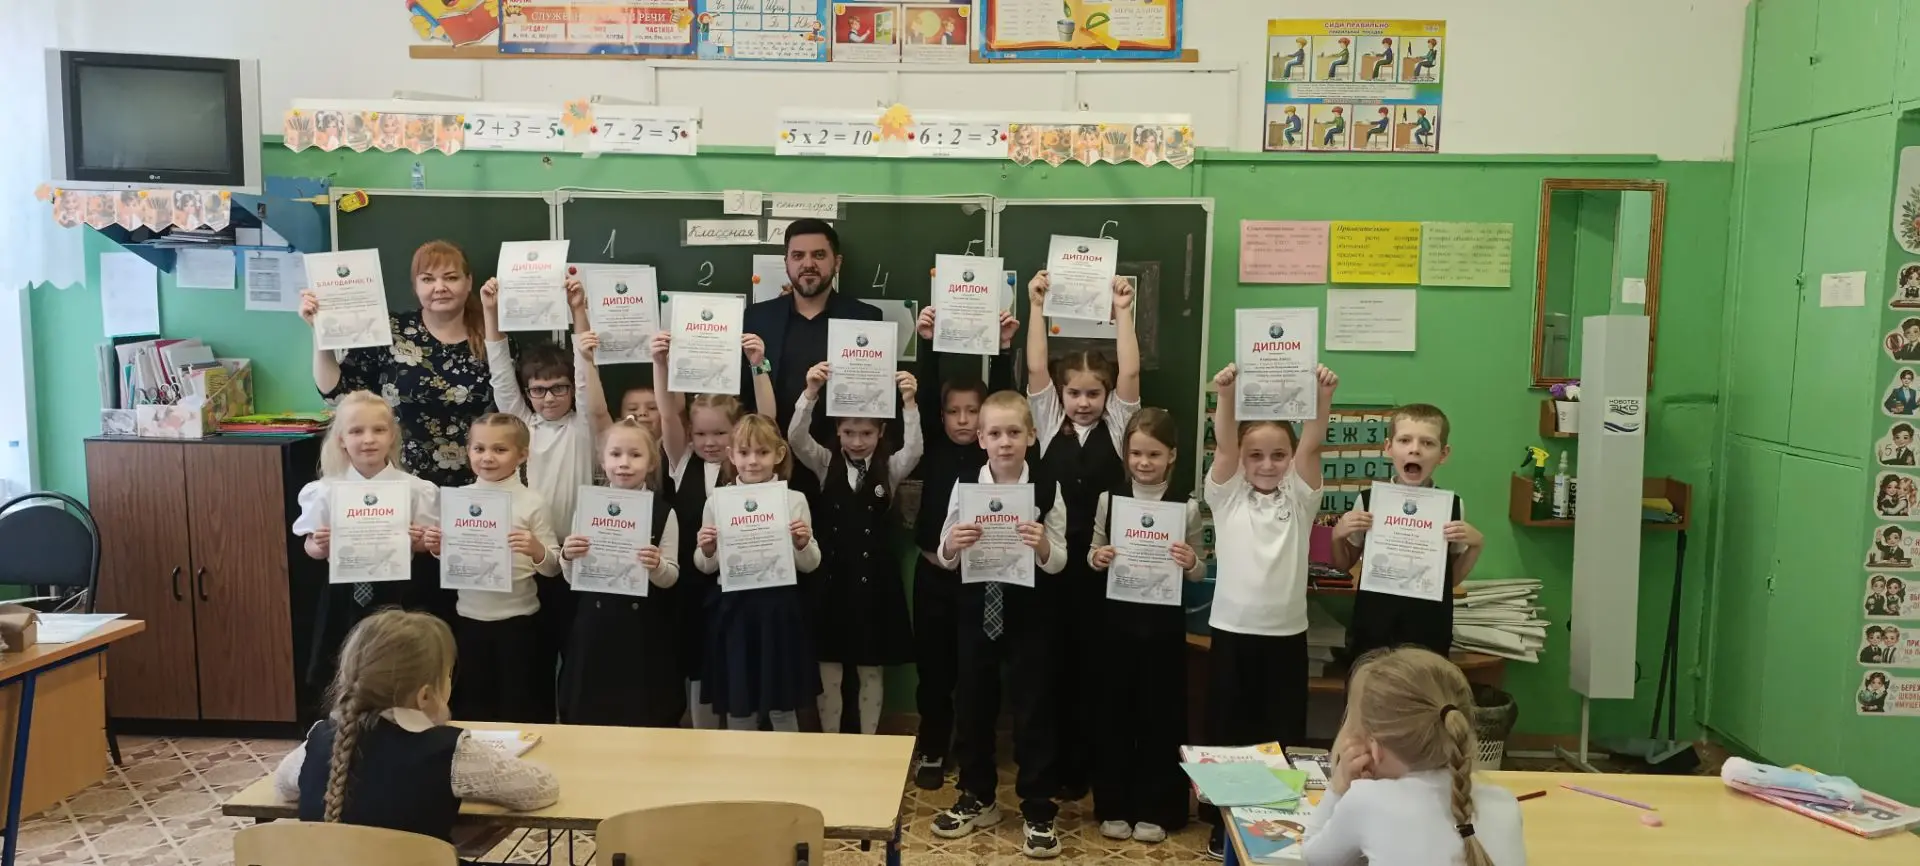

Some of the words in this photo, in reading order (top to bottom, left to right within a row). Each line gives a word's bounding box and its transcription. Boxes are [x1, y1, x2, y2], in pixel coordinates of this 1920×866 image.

[639, 13, 666, 22] РЕЧИ
[474, 119, 486, 136] 2
[492, 121, 504, 136] +
[509, 120, 521, 138] 3
[546, 122, 558, 139] 5
[604, 122, 614, 138] 7
[632, 124, 644, 140] 2
[668, 126, 680, 142] 5
[787, 128, 797, 144] 5
[818, 128, 828, 144] 2
[852, 130, 872, 146] 10
[920, 128, 930, 144] 6
[950, 128, 962, 146] 2
[986, 129, 998, 146] 3
[688, 225, 756, 239] Классная
[602, 229, 616, 258] 1
[1062, 254, 1102, 262] ДИПЛОМ
[512, 262, 552, 272] ДИПЛОМ
[698, 260, 714, 286] 2
[872, 264, 890, 296] 4
[948, 284, 988, 294] ДИПЛОМ
[602, 296, 644, 306] ДИПЛОМ
[686, 322, 728, 332] ДИПЛОМ
[1252, 342, 1301, 352] ДИПЛОМ
[842, 349, 882, 358] ДИПЛОМ
[1326, 428, 1336, 442] Е
[1343, 428, 1358, 442] Ж
[1367, 428, 1377, 443] З
[1344, 464, 1356, 477] Р
[1365, 462, 1376, 478] С
[347, 508, 394, 518] ДИПЛОМ
[974, 514, 1019, 524] ДИПЛОМ
[454, 518, 496, 528] ДИПЛОМ
[592, 518, 636, 529] ДИПЛОМ
[730, 513, 774, 526] ДИПЛОМ
[1384, 516, 1432, 529] ДИПЛОМ
[1126, 528, 1168, 540] ДИПЛОМ
